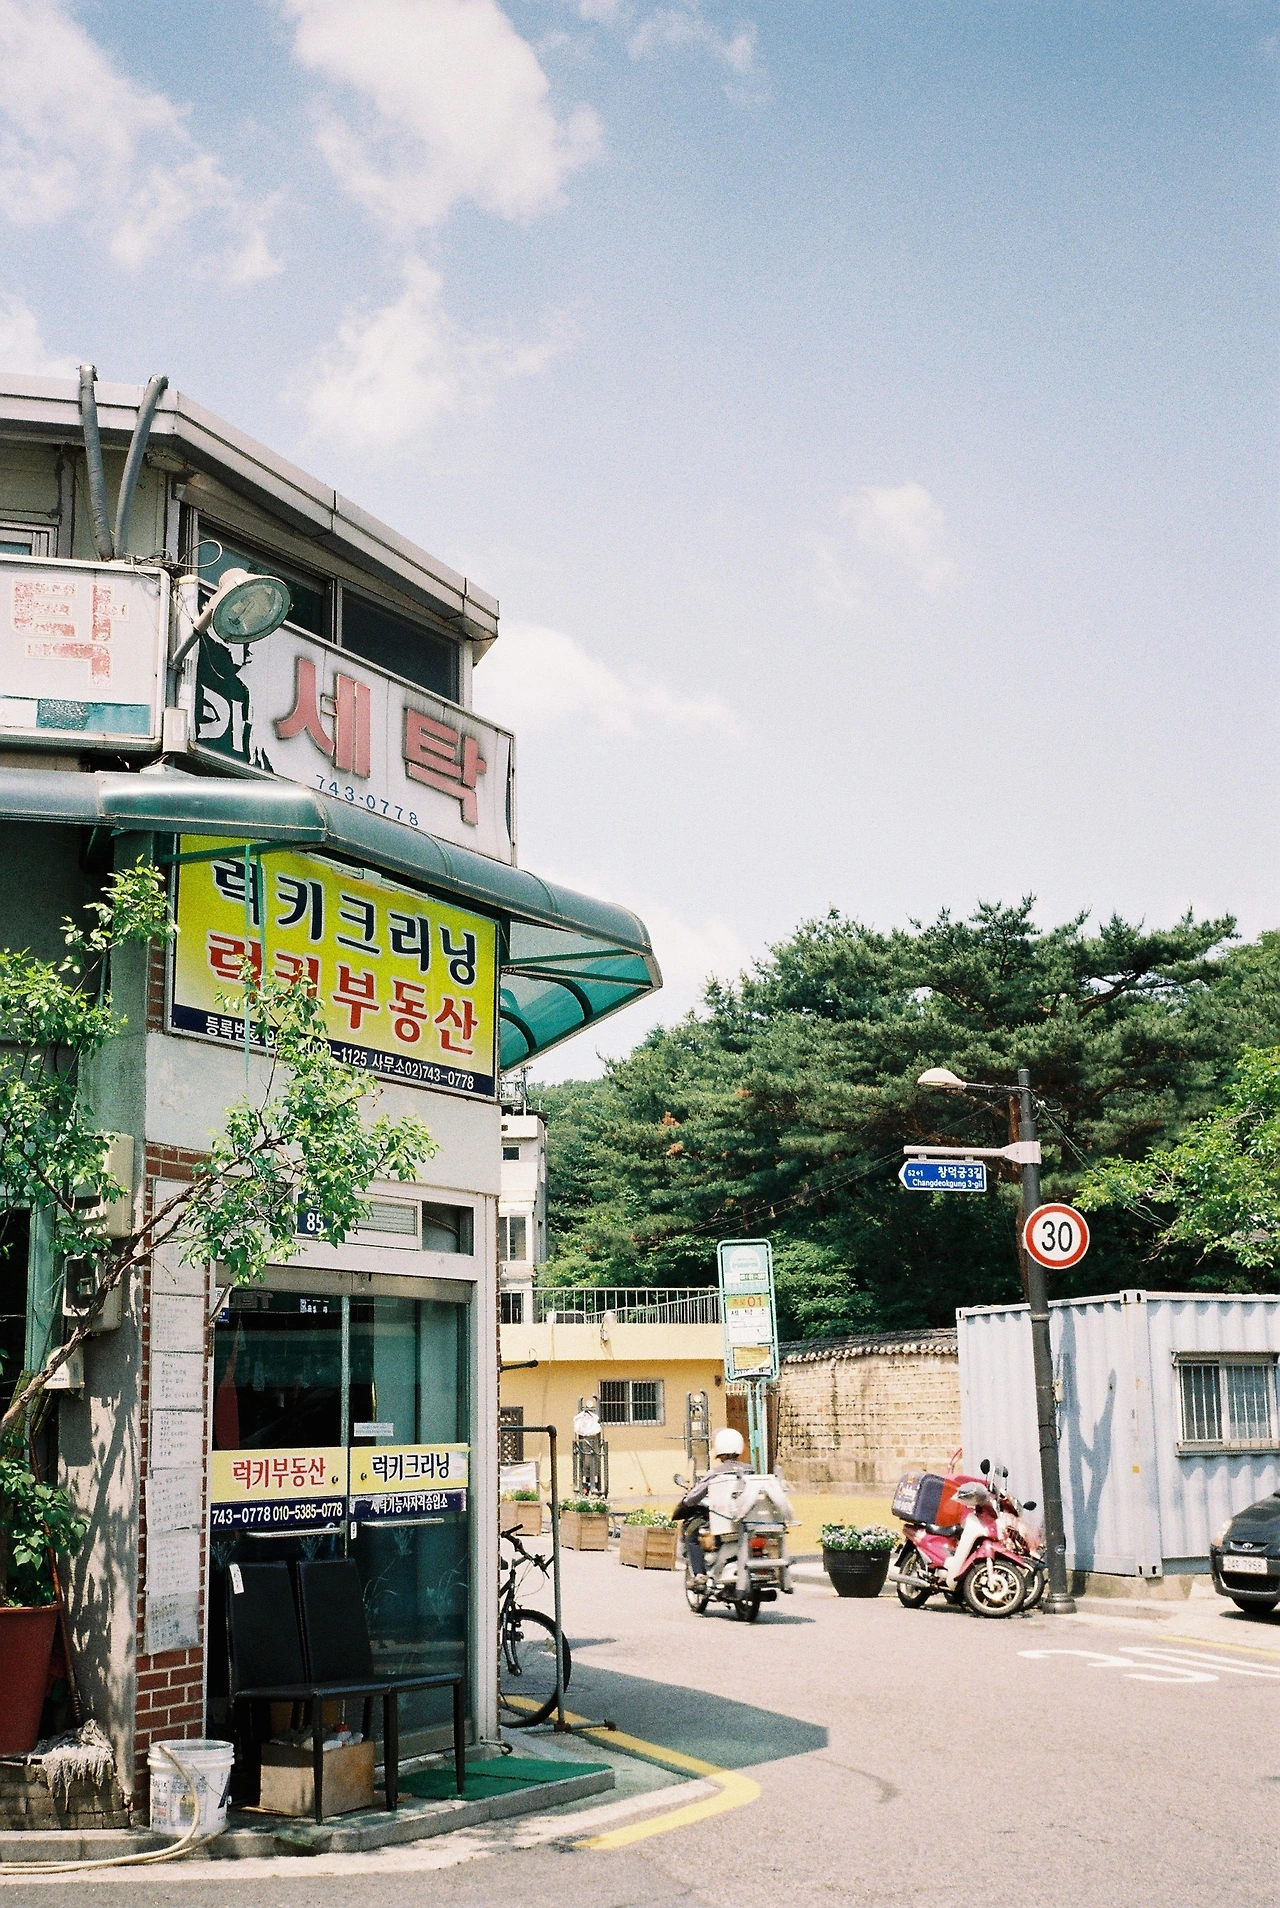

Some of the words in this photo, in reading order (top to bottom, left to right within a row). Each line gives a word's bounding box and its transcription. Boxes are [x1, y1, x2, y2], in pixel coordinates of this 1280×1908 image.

[275, 656, 487, 826] 세탁
[316, 774, 420, 827] 743-0778
[213, 858, 476, 985] 럭키크리닝
[912, 1178, 966, 1188] Changdeokgung
[967, 1180, 983, 1188] 3-gil
[938, 1166, 983, 1179] 창덕궁3길
[307, 1212, 324, 1231] 85
[1041, 1220, 1073, 1253] 30
[233, 1457, 326, 1489] 럭키부동산
[372, 1452, 450, 1482] 럭키크리닝
[212, 1506, 271, 1525] 743-0778
[272, 1502, 343, 1522] 010-5385-0778
